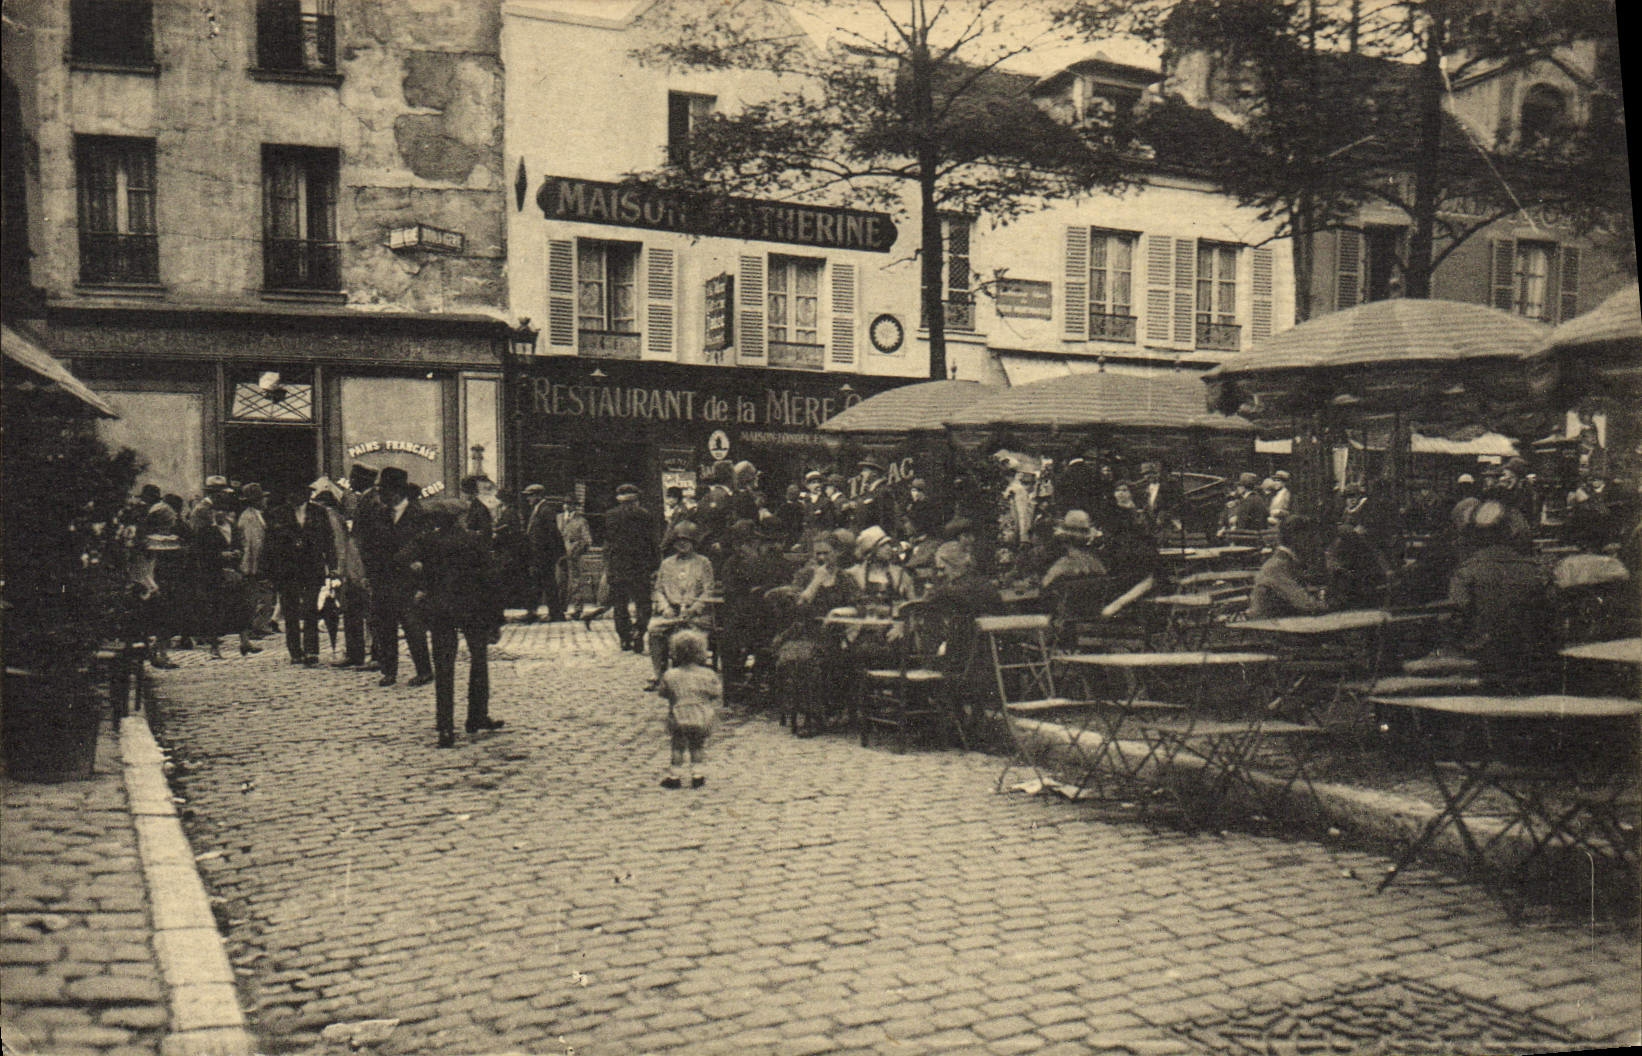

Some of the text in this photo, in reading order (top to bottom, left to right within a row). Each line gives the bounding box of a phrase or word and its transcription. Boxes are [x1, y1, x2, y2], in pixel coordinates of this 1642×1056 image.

[532, 376, 697, 421] RESTAURANT
[703, 395, 728, 422] de
[736, 396, 756, 424] la
